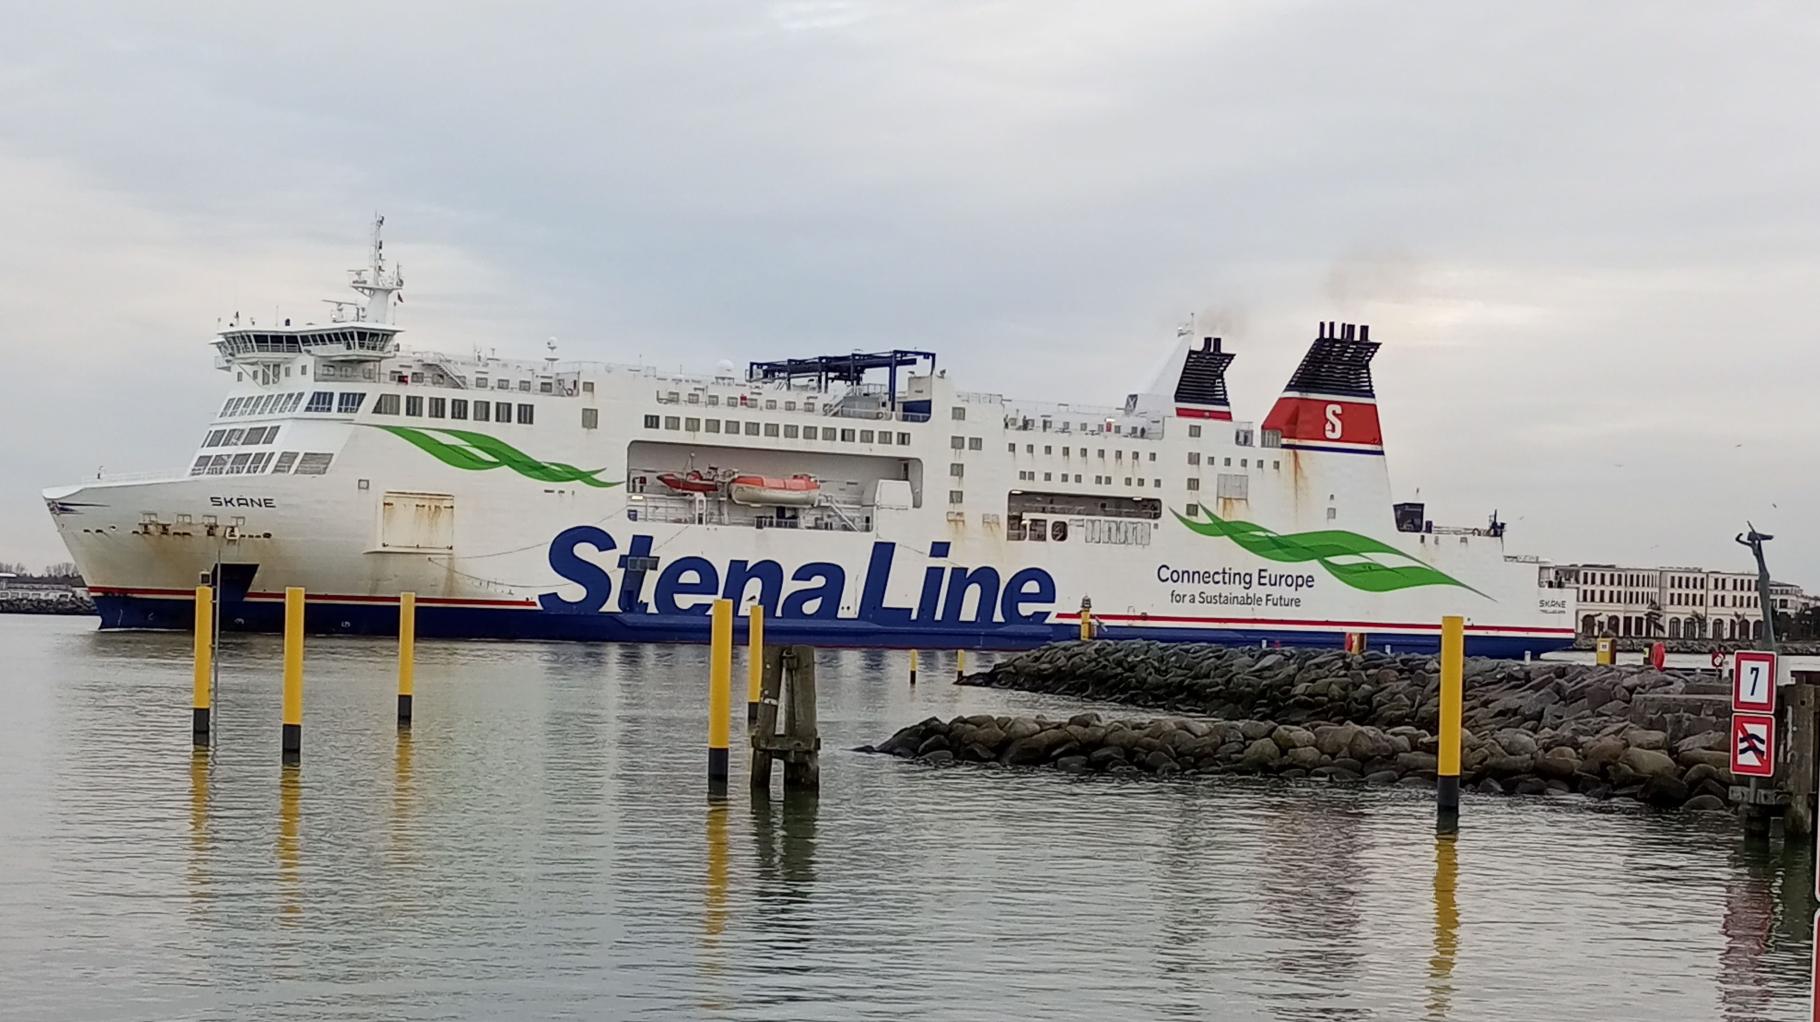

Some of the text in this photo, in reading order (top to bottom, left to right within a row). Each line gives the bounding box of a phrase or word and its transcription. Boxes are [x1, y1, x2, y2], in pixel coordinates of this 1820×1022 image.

[538, 525, 1056, 625] Stena Line
[1157, 564, 1315, 591] Connecting Europe
[1170, 590, 1302, 607] for a Sustainable Future
[1750, 667, 1760, 696] 7
